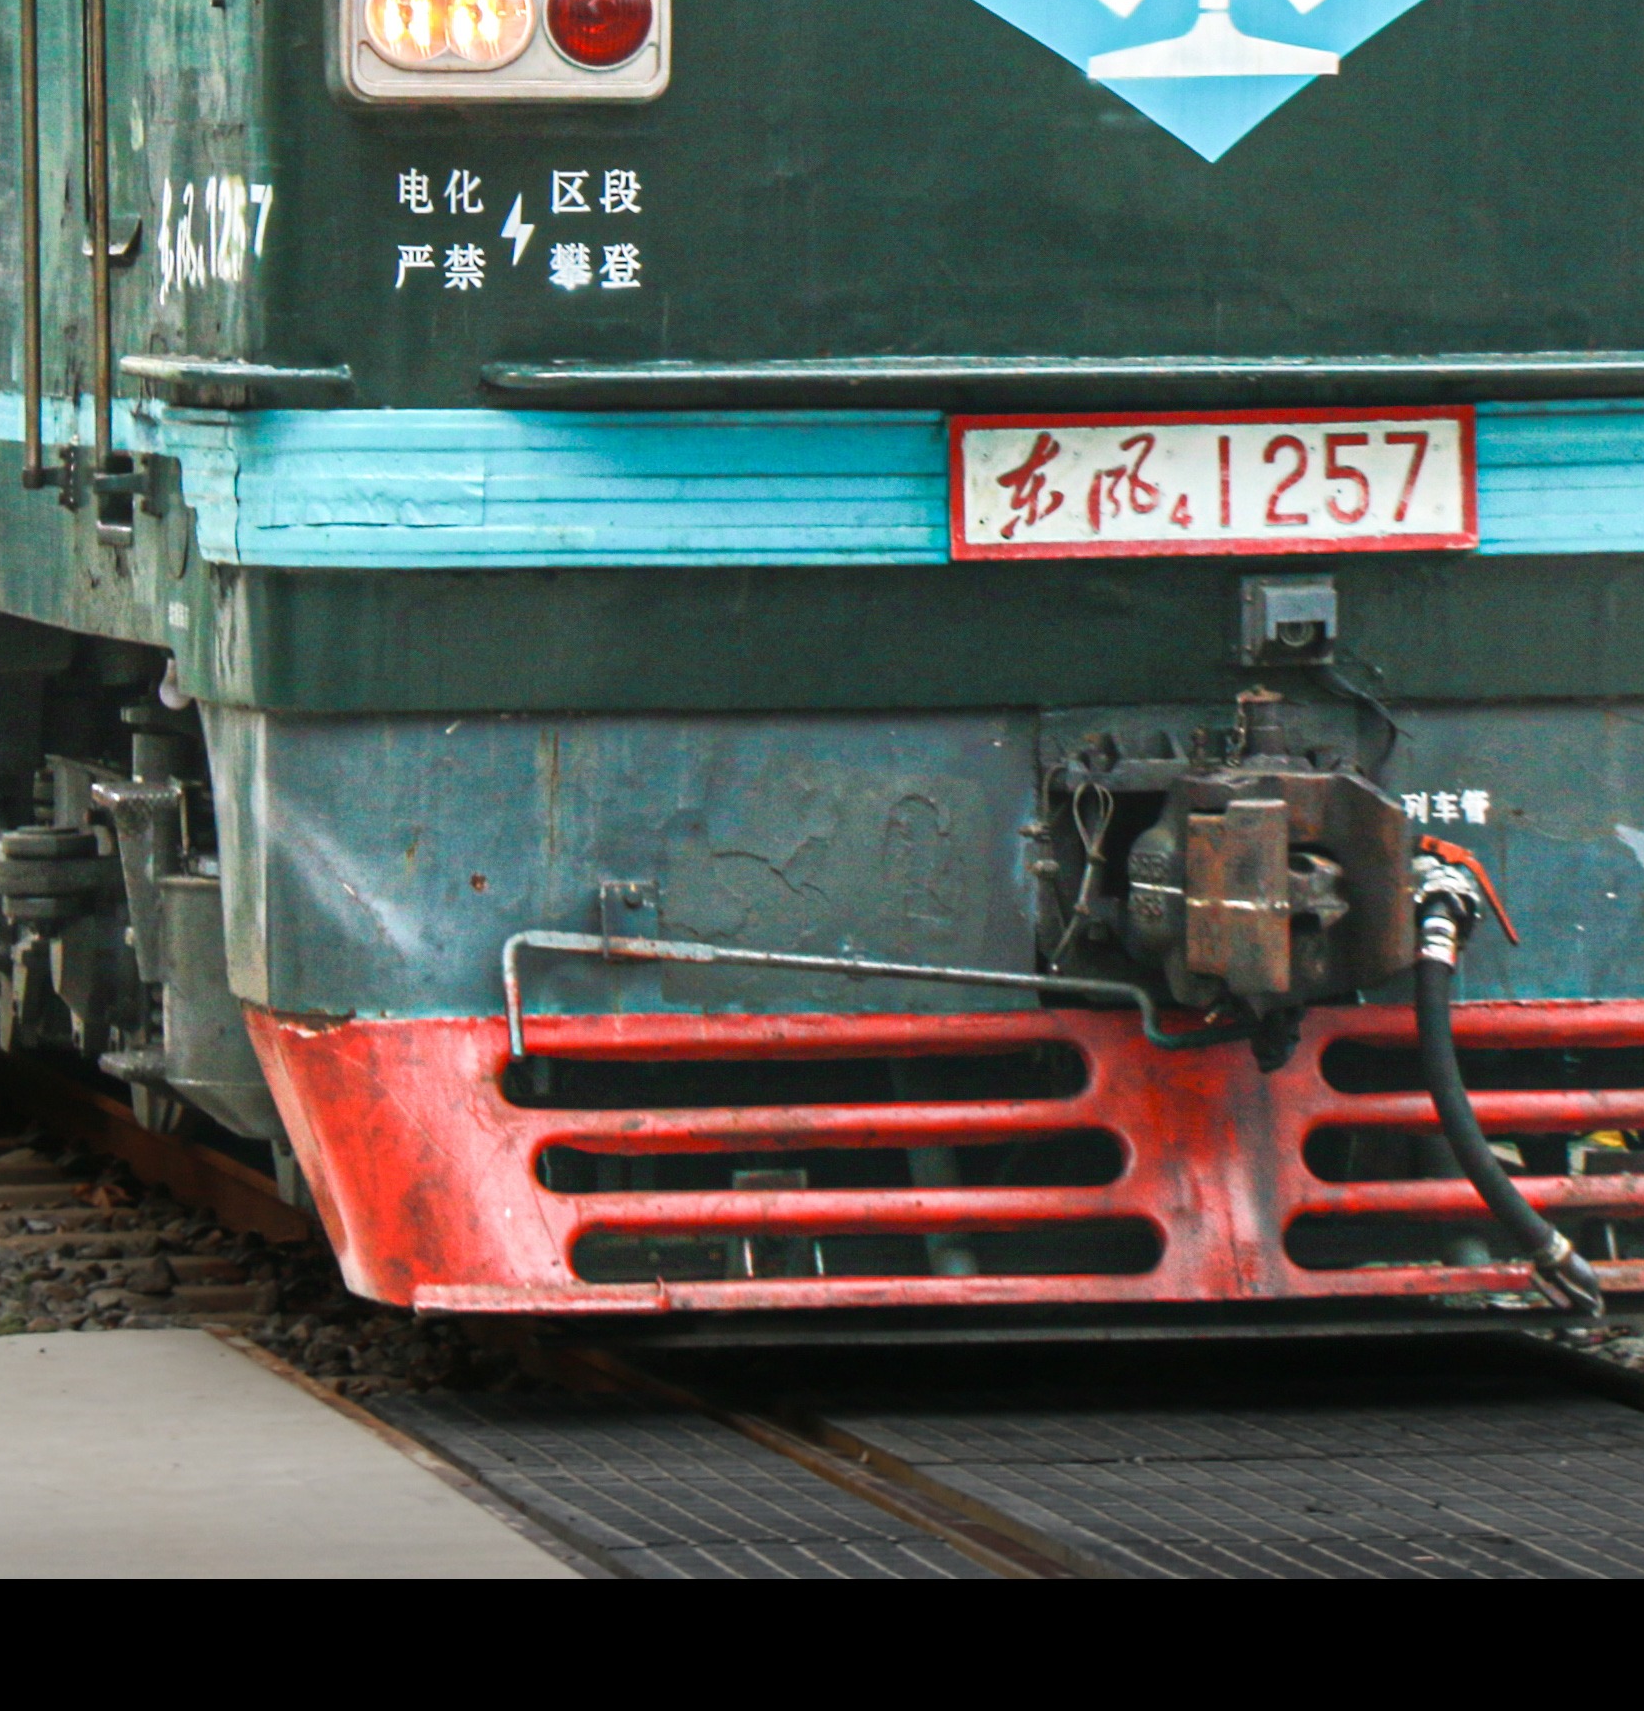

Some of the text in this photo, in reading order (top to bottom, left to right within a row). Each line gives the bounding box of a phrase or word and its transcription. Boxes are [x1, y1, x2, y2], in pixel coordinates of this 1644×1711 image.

[398, 167, 642, 215] 电化 区段
[395, 242, 642, 291] 严禁 攀登
[1219, 430, 1430, 528] 1257
